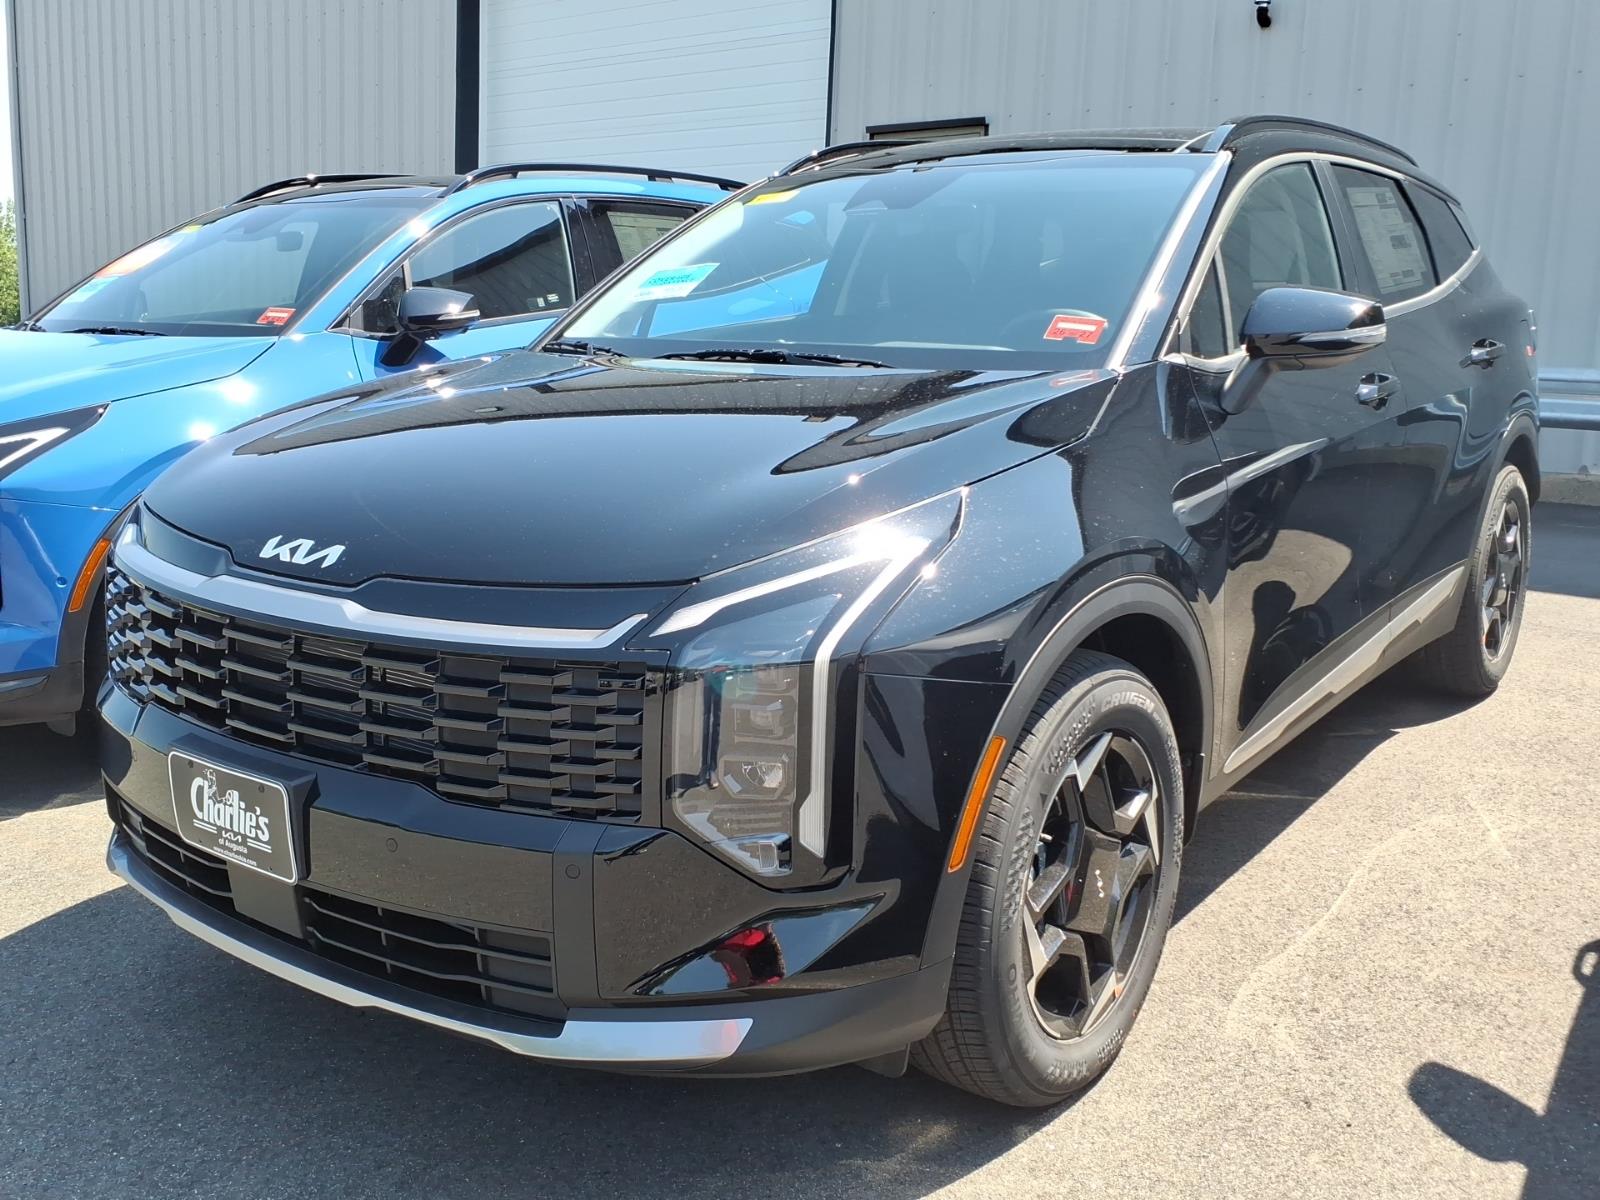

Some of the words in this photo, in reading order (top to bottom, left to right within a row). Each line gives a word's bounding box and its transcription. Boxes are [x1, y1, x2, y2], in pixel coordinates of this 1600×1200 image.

[259, 535, 346, 569] KIA
[1101, 691, 1155, 713] CRUGEN
[190, 777, 270, 842] Charlie's
[225, 840, 248, 854] Augusta
